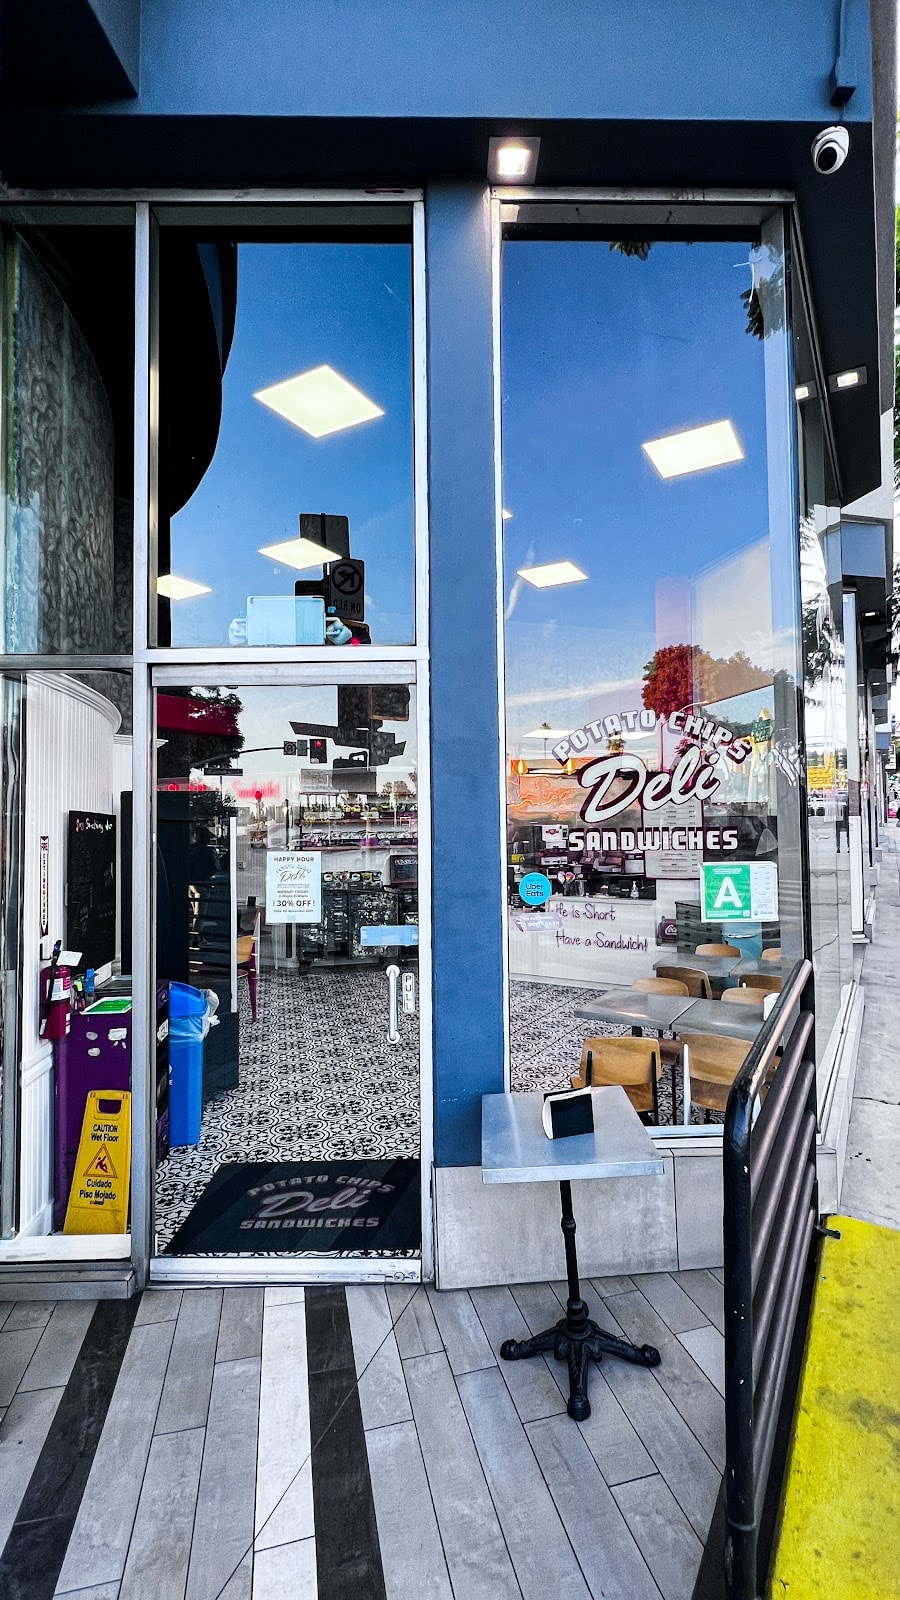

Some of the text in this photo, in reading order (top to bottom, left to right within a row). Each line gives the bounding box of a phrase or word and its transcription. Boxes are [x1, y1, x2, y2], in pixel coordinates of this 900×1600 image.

[552, 709, 753, 766] POTATO CHIPS
[577, 743, 721, 823] Deli
[568, 827, 738, 851] SANDWICHES
[713, 876, 743, 908] A
[583, 902, 616, 921] Short
[555, 930, 581, 947] Have
[584, 938, 592, 947] a
[91, 1132, 119, 1142] Wet Floor
[93, 1124, 118, 1132] CAUTION
[86, 1178, 112, 1188] Cuidado
[247, 1174, 396, 1196] POTATO CHIPS
[79, 1189, 117, 1200] Piso Mojado
[256, 1187, 372, 1218] Deli
[240, 1216, 379, 1229] SANDWICHES
